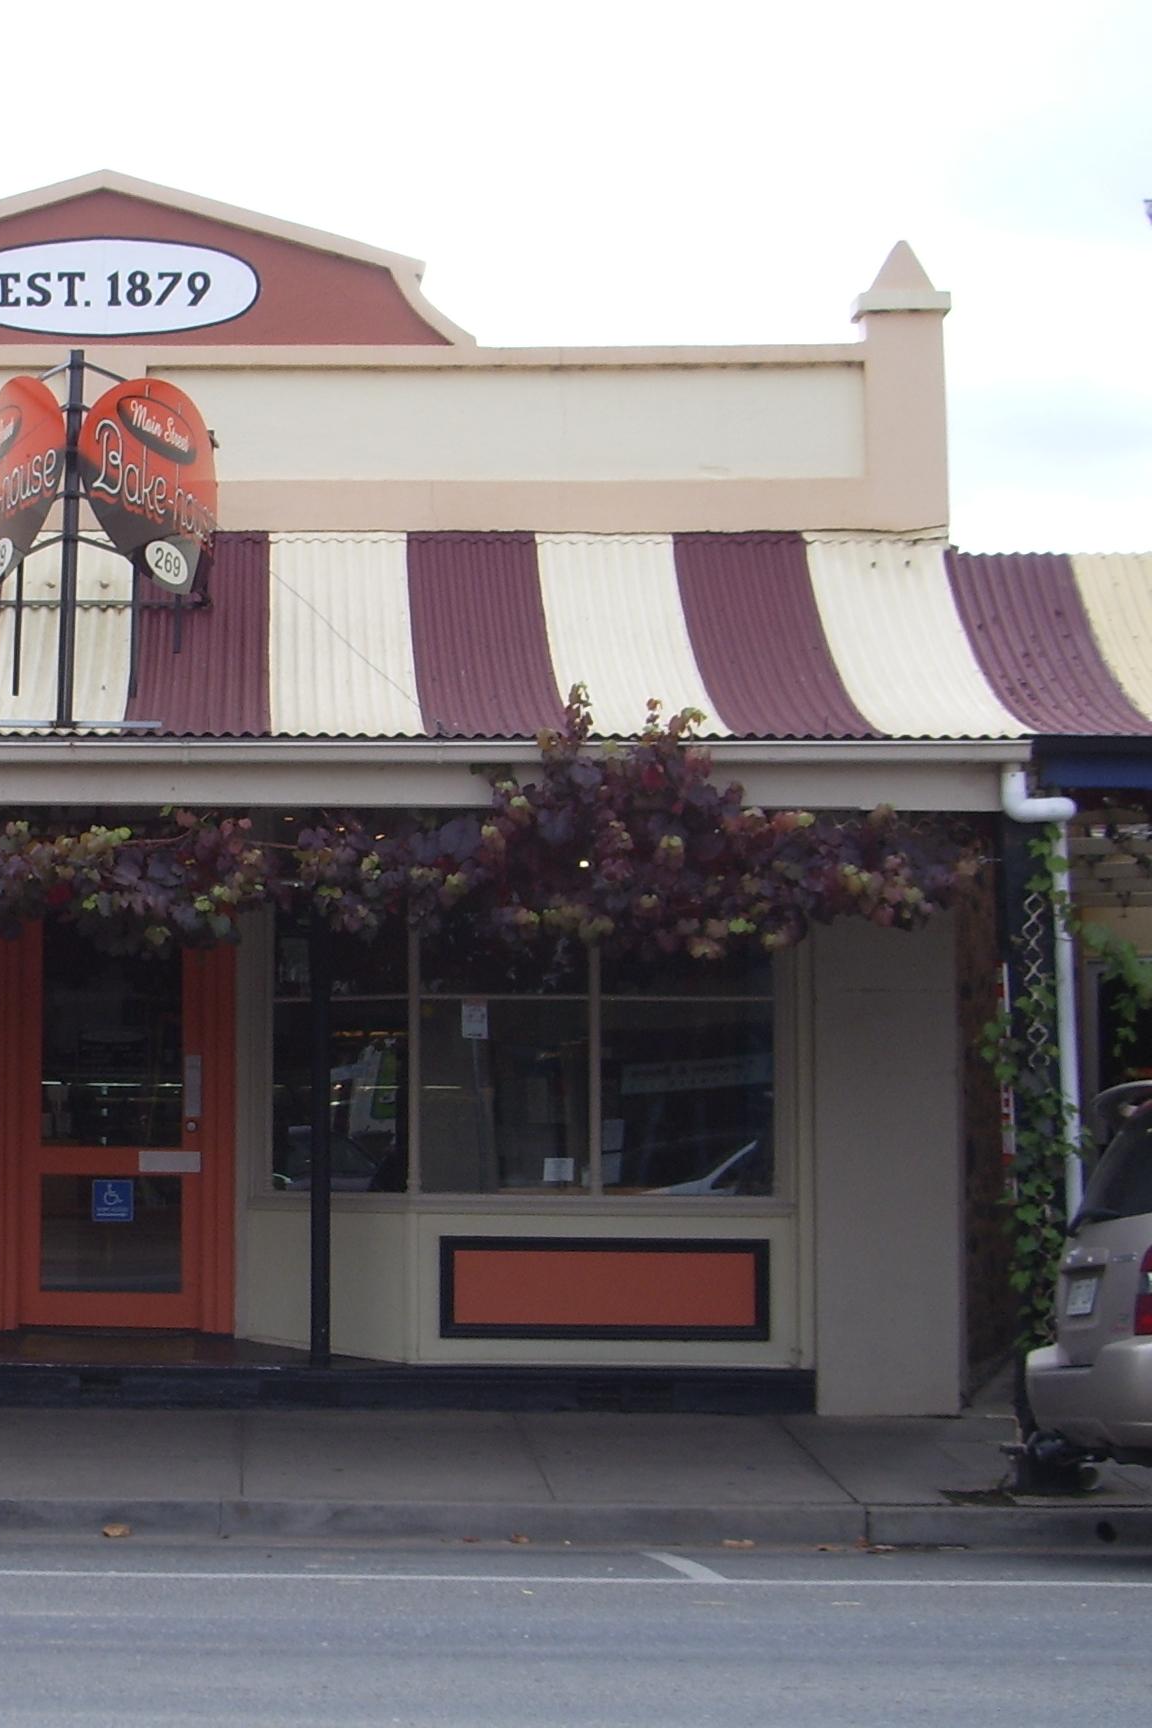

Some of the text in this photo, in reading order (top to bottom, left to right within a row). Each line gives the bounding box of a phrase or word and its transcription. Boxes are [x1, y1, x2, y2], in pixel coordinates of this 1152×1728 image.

[107, 270, 212, 307] 1879
[130, 400, 162, 438] Main
[154, 547, 182, 578] 269
